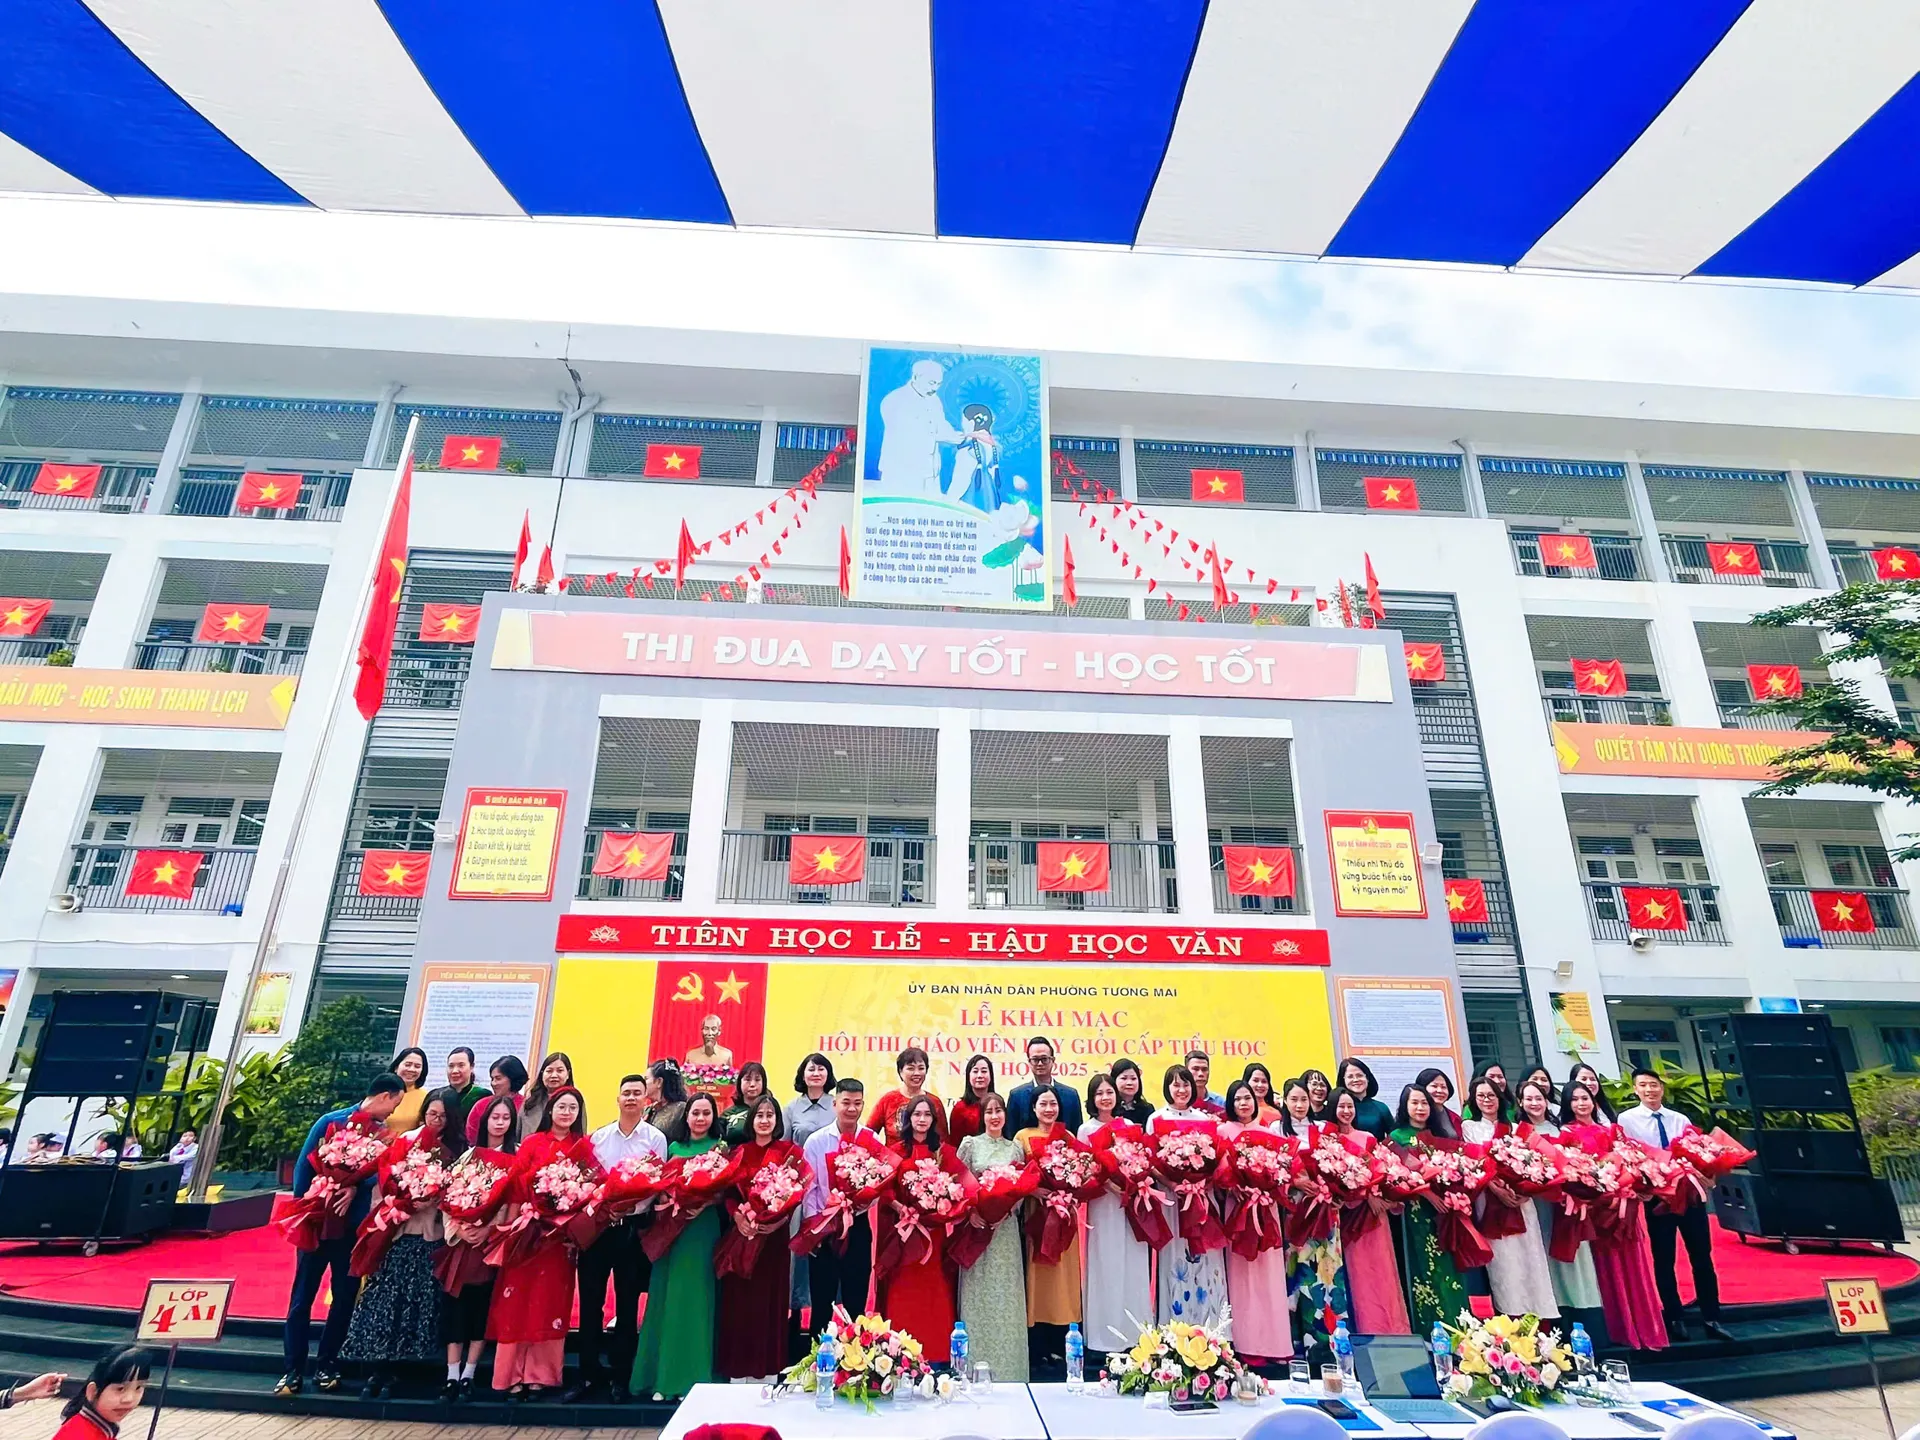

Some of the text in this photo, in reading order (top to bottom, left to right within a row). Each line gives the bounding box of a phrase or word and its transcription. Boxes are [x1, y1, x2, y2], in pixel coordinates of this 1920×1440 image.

[622, 632, 1276, 688] THI ĐUA DẠY TỐT - HỌC TỐT
[28, 681, 68, 711] MỰC
[79, 684, 115, 713] HỌC
[115, 685, 154, 710] SINH
[157, 687, 210, 712] THANH
[211, 689, 249, 718] LỊCH
[1594, 733, 1637, 763] QUYẾT
[1637, 736, 1668, 763] TÂM
[1668, 736, 1696, 765] XÂY
[1698, 740, 1736, 770] DỰNG
[768, 927, 852, 954] HỌC
[871, 922, 922, 951] LỄ
[968, 927, 1048, 958] HẬU
[1068, 933, 1148, 960] HỌC
[1167, 930, 1243, 957] VĂN
[908, 981, 1178, 997] ỦY BAN NHÂN DÂN PHƯỜNG TƯƠNG MAI
[960, 1001, 1129, 1031] LỄ KHAI MẠC
[819, 1031, 858, 1056] HỘI
[864, 1035, 900, 1052] THI
[907, 1031, 962, 1053] GIÁO
[967, 1032, 1017, 1053] VIÊN
[1071, 1033, 1116, 1056] GIỎI
[1123, 1031, 1164, 1057] CẤP
[1168, 1032, 1216, 1056] TIỂU
[1223, 1040, 1267, 1060] HỌC
[1000, 1062, 1030, 1080] HỌ
[1051, 1062, 1088, 1077] 2025
[169, 1288, 209, 1302] LỚP
